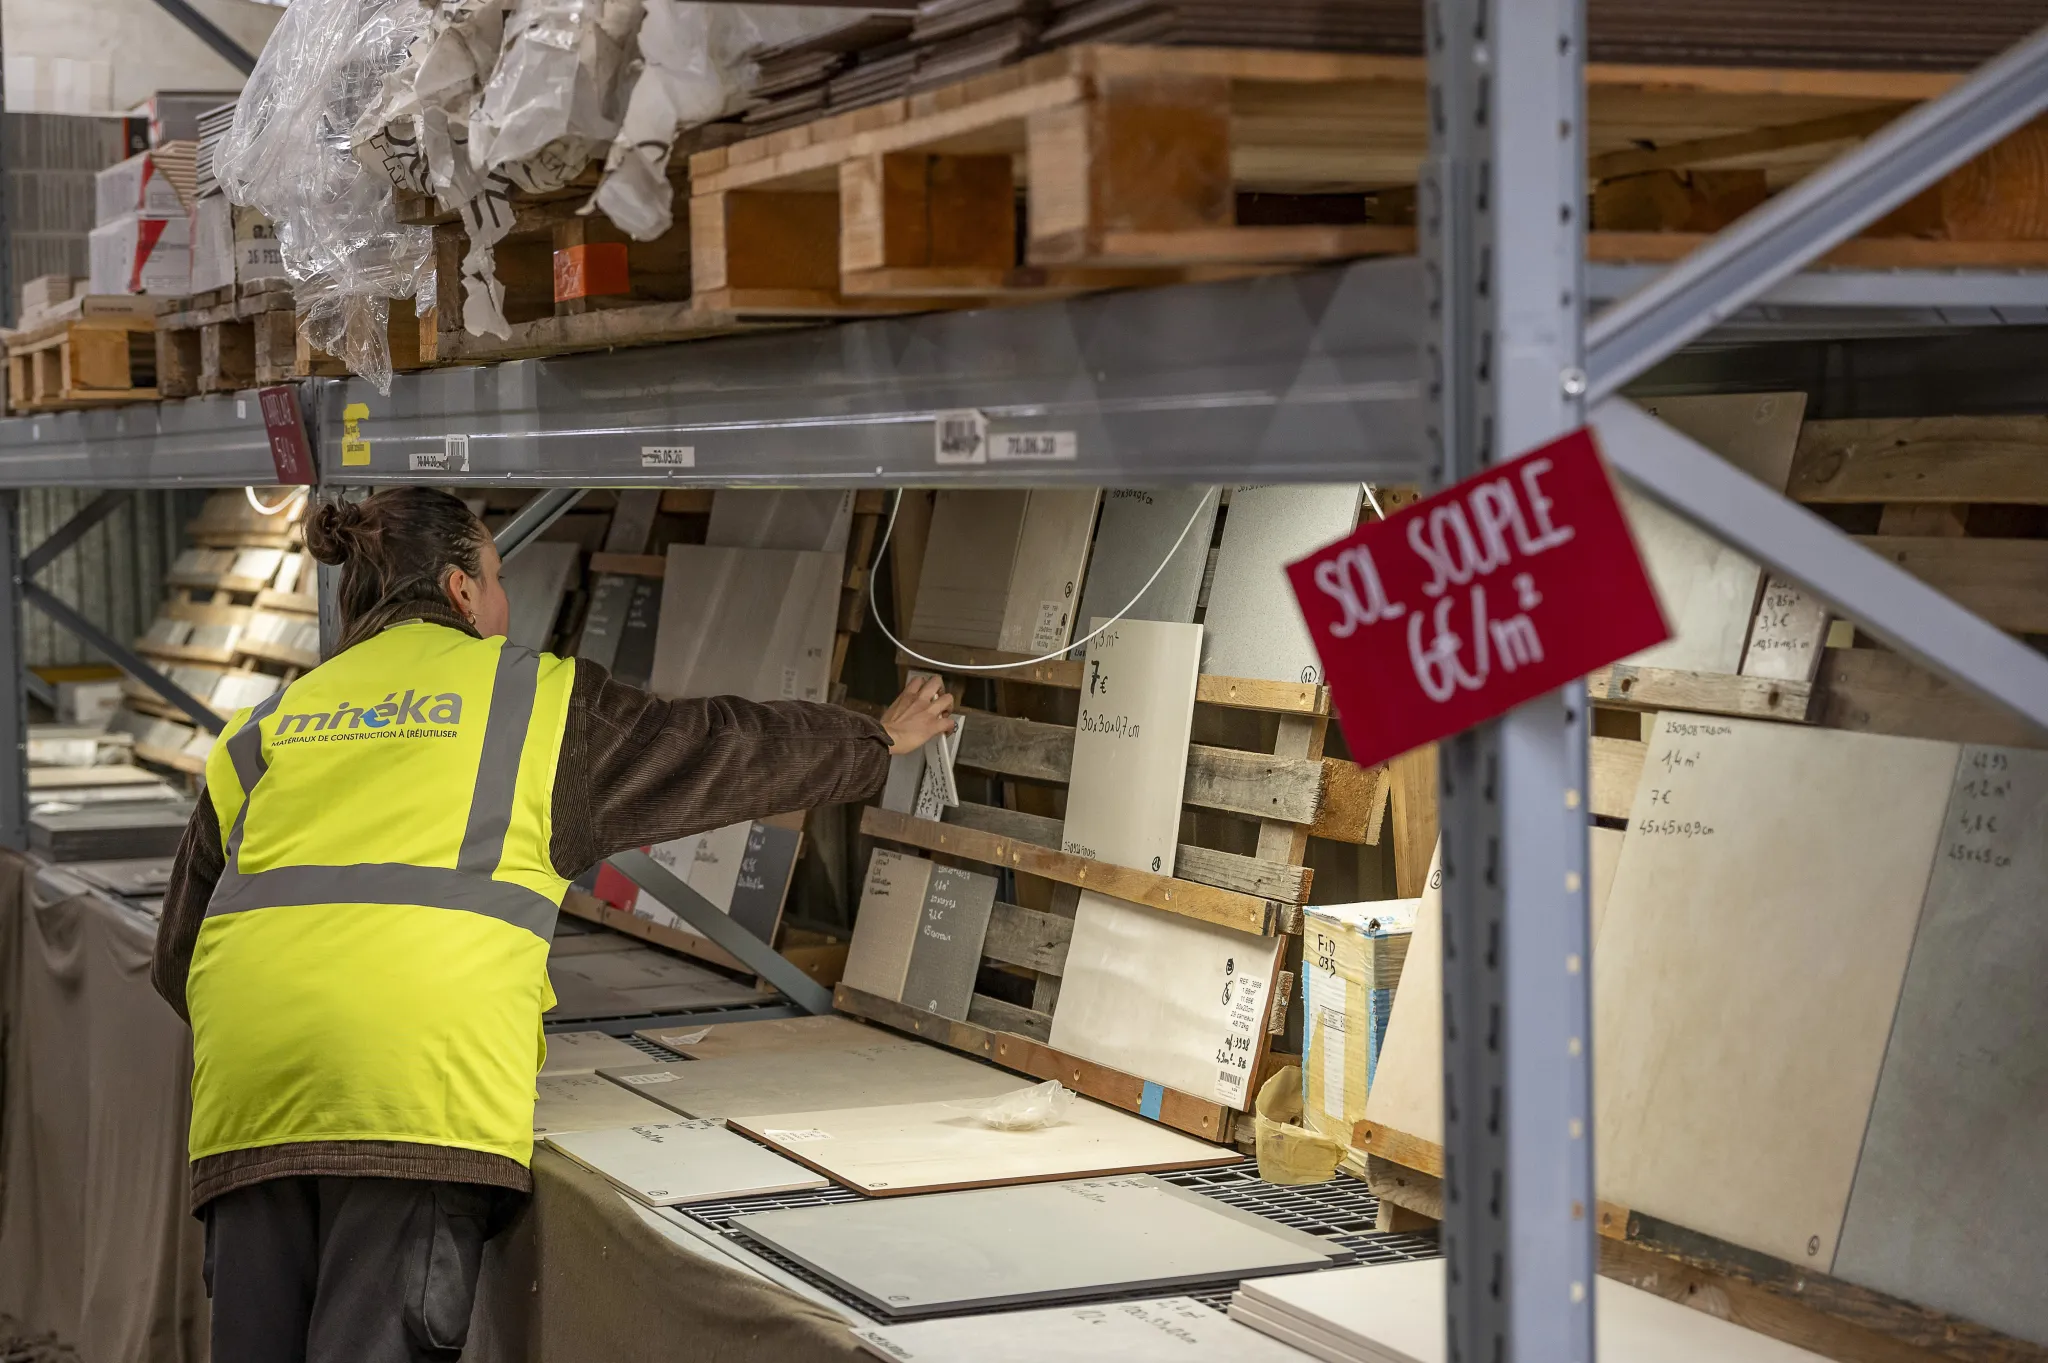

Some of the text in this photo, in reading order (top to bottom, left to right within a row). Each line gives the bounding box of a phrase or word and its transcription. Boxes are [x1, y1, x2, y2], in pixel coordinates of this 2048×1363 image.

[1314, 457, 1576, 638] SOL SOUPLE
[1406, 572, 1546, 703] 6€/m²
[271, 734, 316, 747] MATÉRIAUX
[318, 734, 329, 742] DE
[331, 731, 396, 741] CONSTRUCTION
[398, 729, 405, 738] À
[274, 689, 463, 736] minéka
